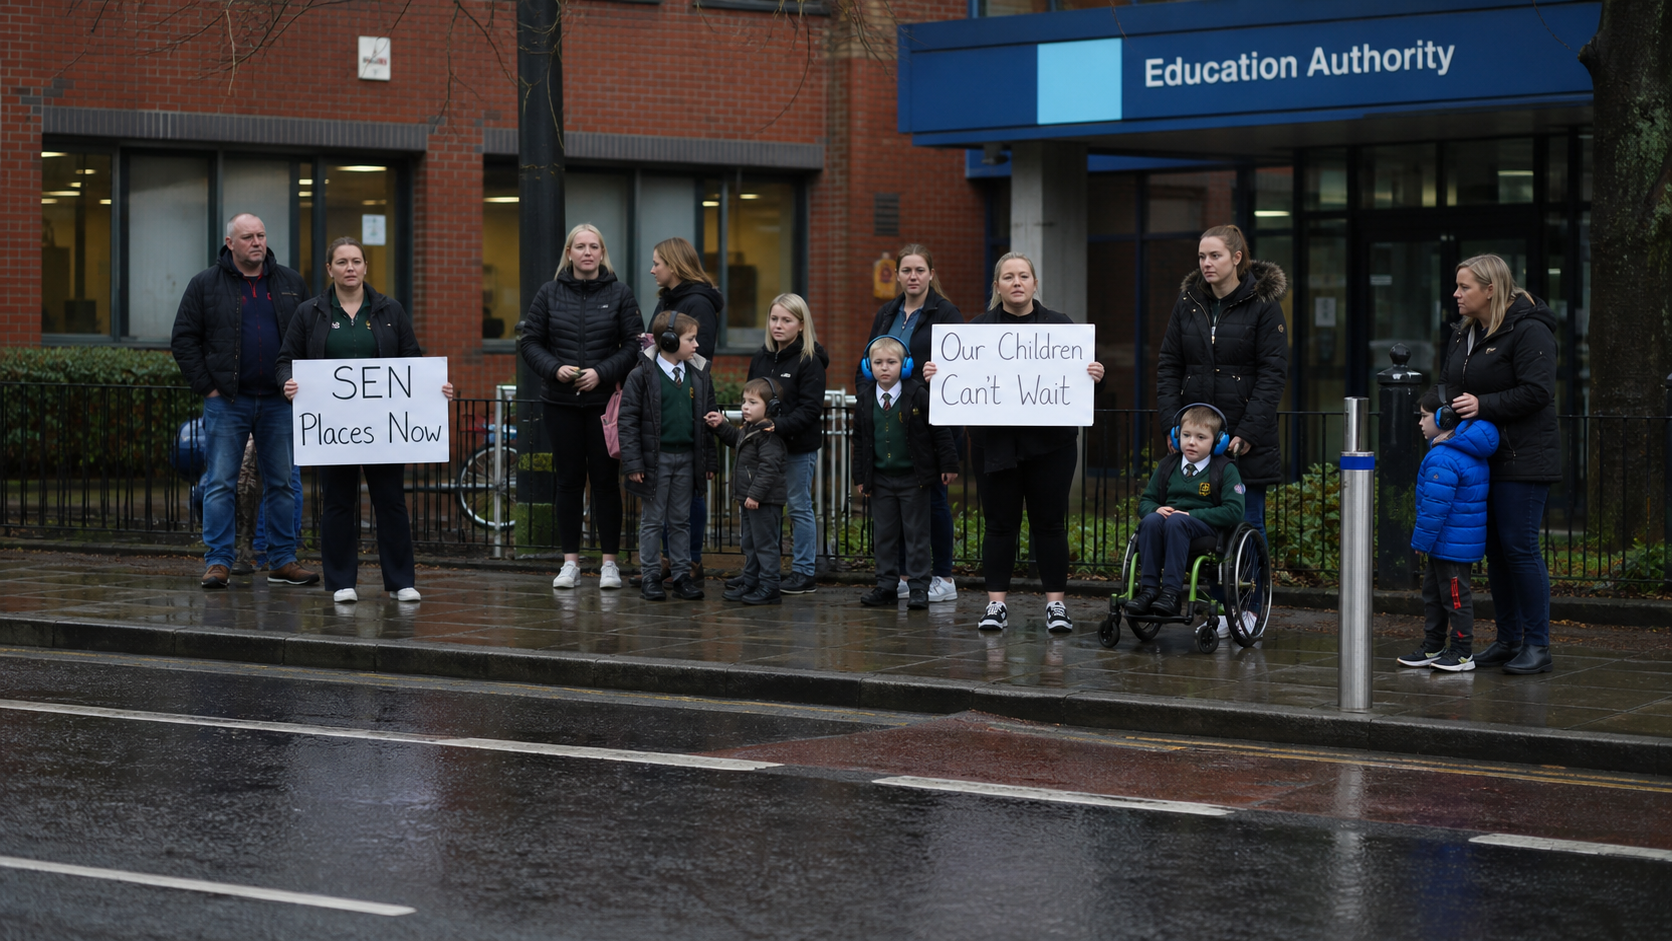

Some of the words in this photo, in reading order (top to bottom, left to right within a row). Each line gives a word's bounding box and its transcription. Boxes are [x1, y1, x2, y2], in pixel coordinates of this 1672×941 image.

[1145, 51, 1299, 88] Education
[1306, 40, 1455, 77] Authority
[941, 331, 986, 362] Our
[998, 331, 1084, 361] Children
[332, 365, 412, 400] SEN
[941, 373, 1001, 406] Can't
[1018, 374, 1071, 405] Wait
[299, 412, 375, 446] Places
[388, 411, 442, 444] Now
